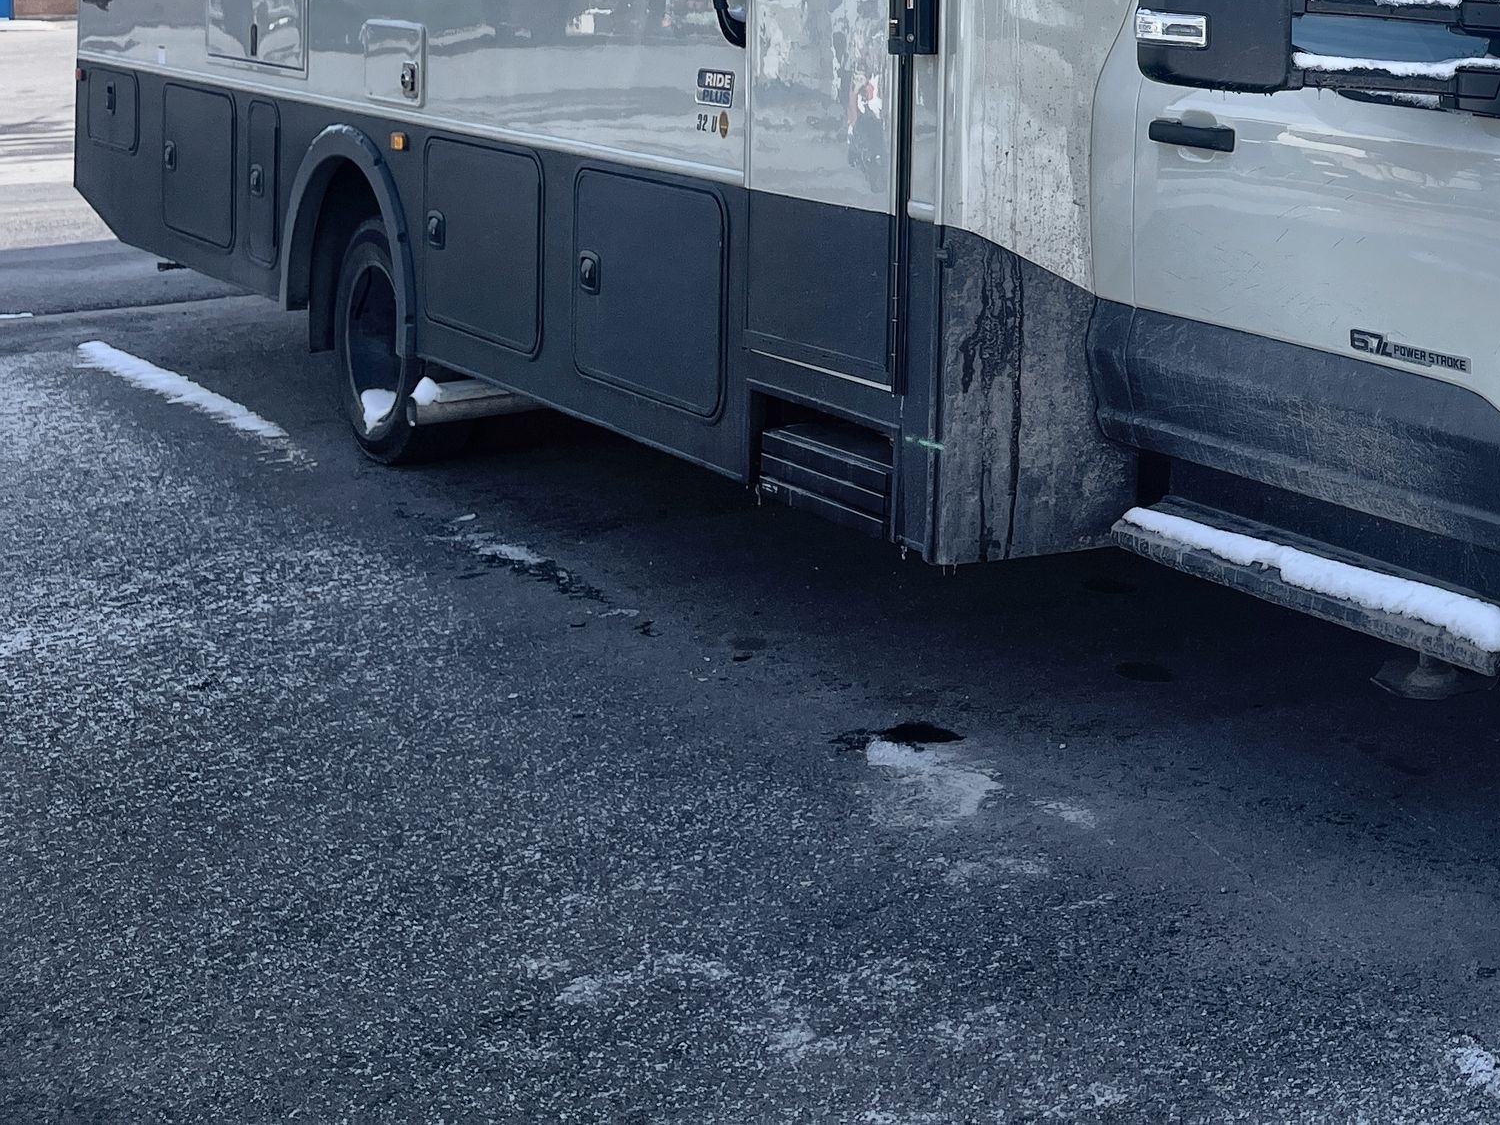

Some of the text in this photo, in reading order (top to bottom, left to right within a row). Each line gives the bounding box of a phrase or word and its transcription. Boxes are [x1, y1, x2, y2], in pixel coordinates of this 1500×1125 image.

[705, 72, 732, 89] RIDE
[702, 89, 731, 105] PLUS
[696, 113, 708, 131] 32
[1393, 344, 1427, 362] POWER
[1428, 352, 1467, 371] STROKE
